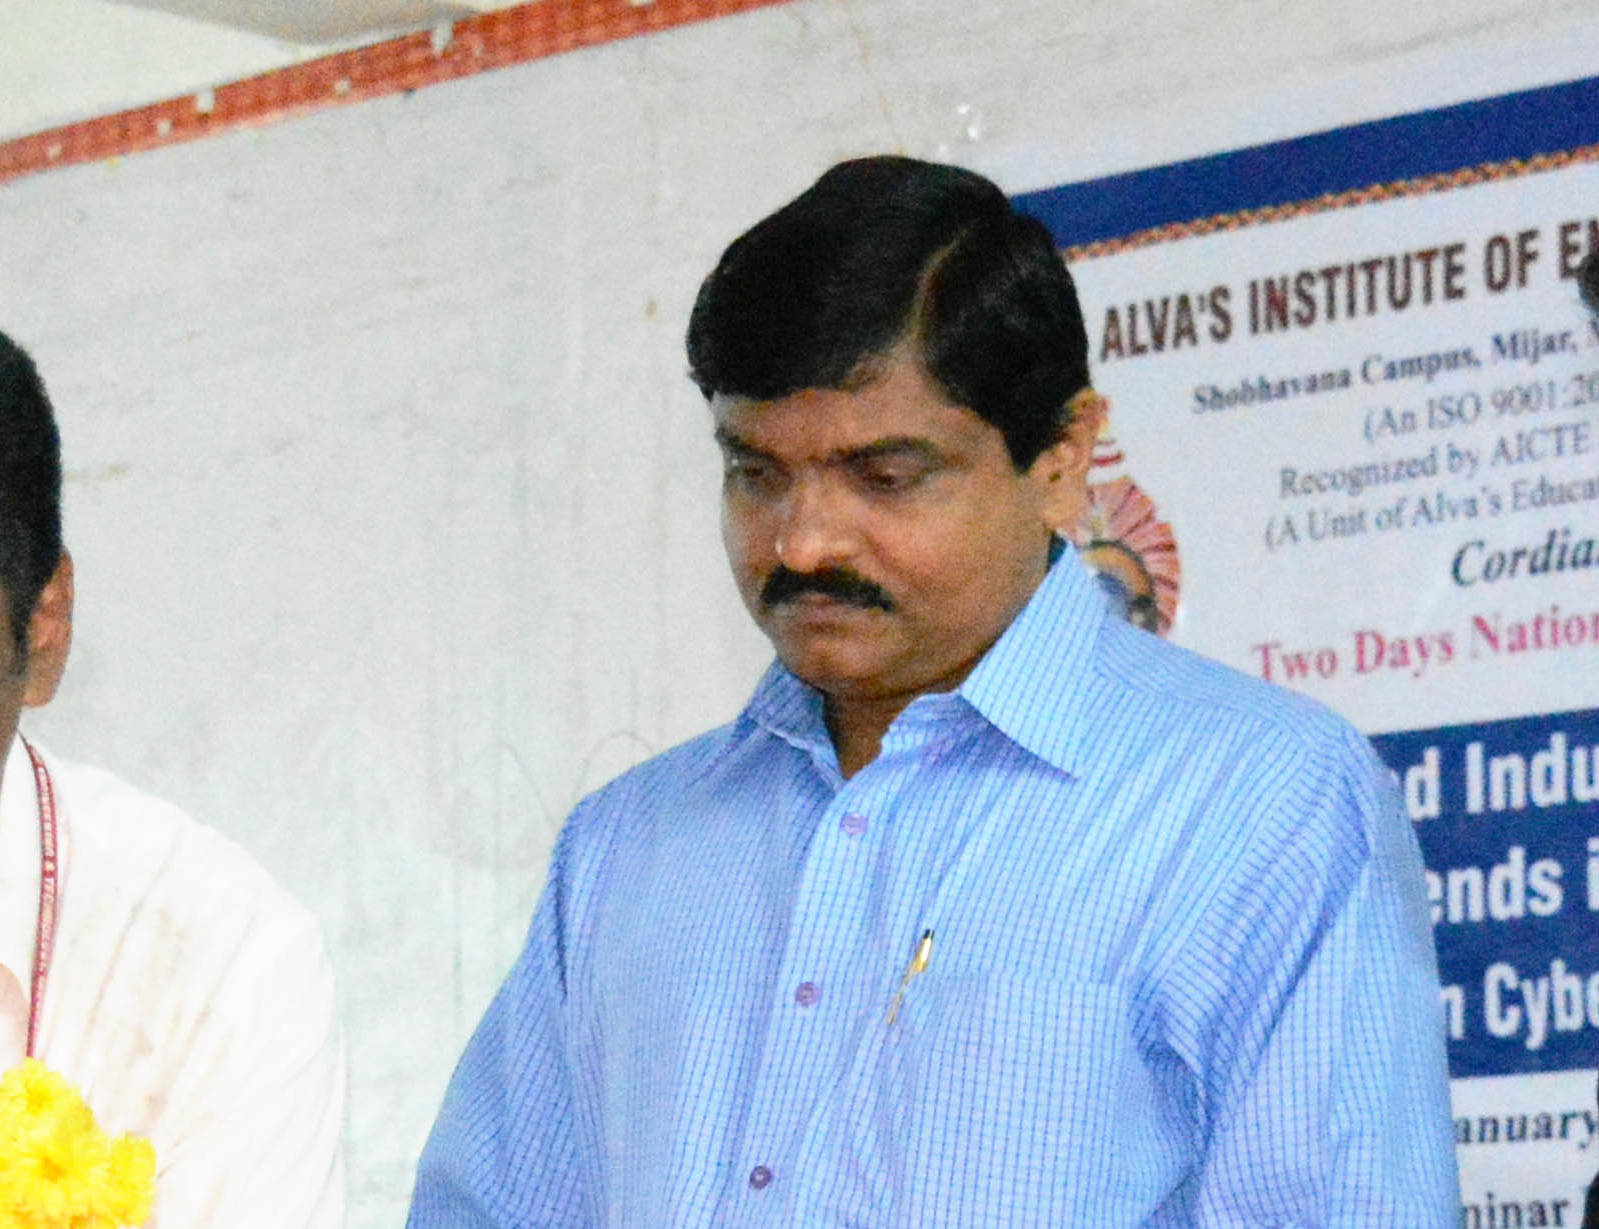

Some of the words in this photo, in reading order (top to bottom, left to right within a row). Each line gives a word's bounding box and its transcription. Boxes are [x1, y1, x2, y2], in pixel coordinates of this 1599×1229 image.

[1100, 284, 1233, 363] ALVA'S
[1248, 243, 1466, 335] INSTITUTE
[1485, 229, 1539, 294] OF
[1193, 369, 1351, 414] Shobhavana
[1361, 353, 1482, 385] Campus,
[1364, 405, 1418, 442] (An
[1428, 391, 1482, 431] ISO
[1280, 446, 1438, 499] Recognized
[1447, 442, 1480, 481] by
[1491, 421, 1590, 467] AICTE
[1307, 507, 1366, 542] Unit
[1375, 497, 1407, 531] of
[1251, 639, 1338, 682] Two
[1352, 629, 1455, 679] Days
